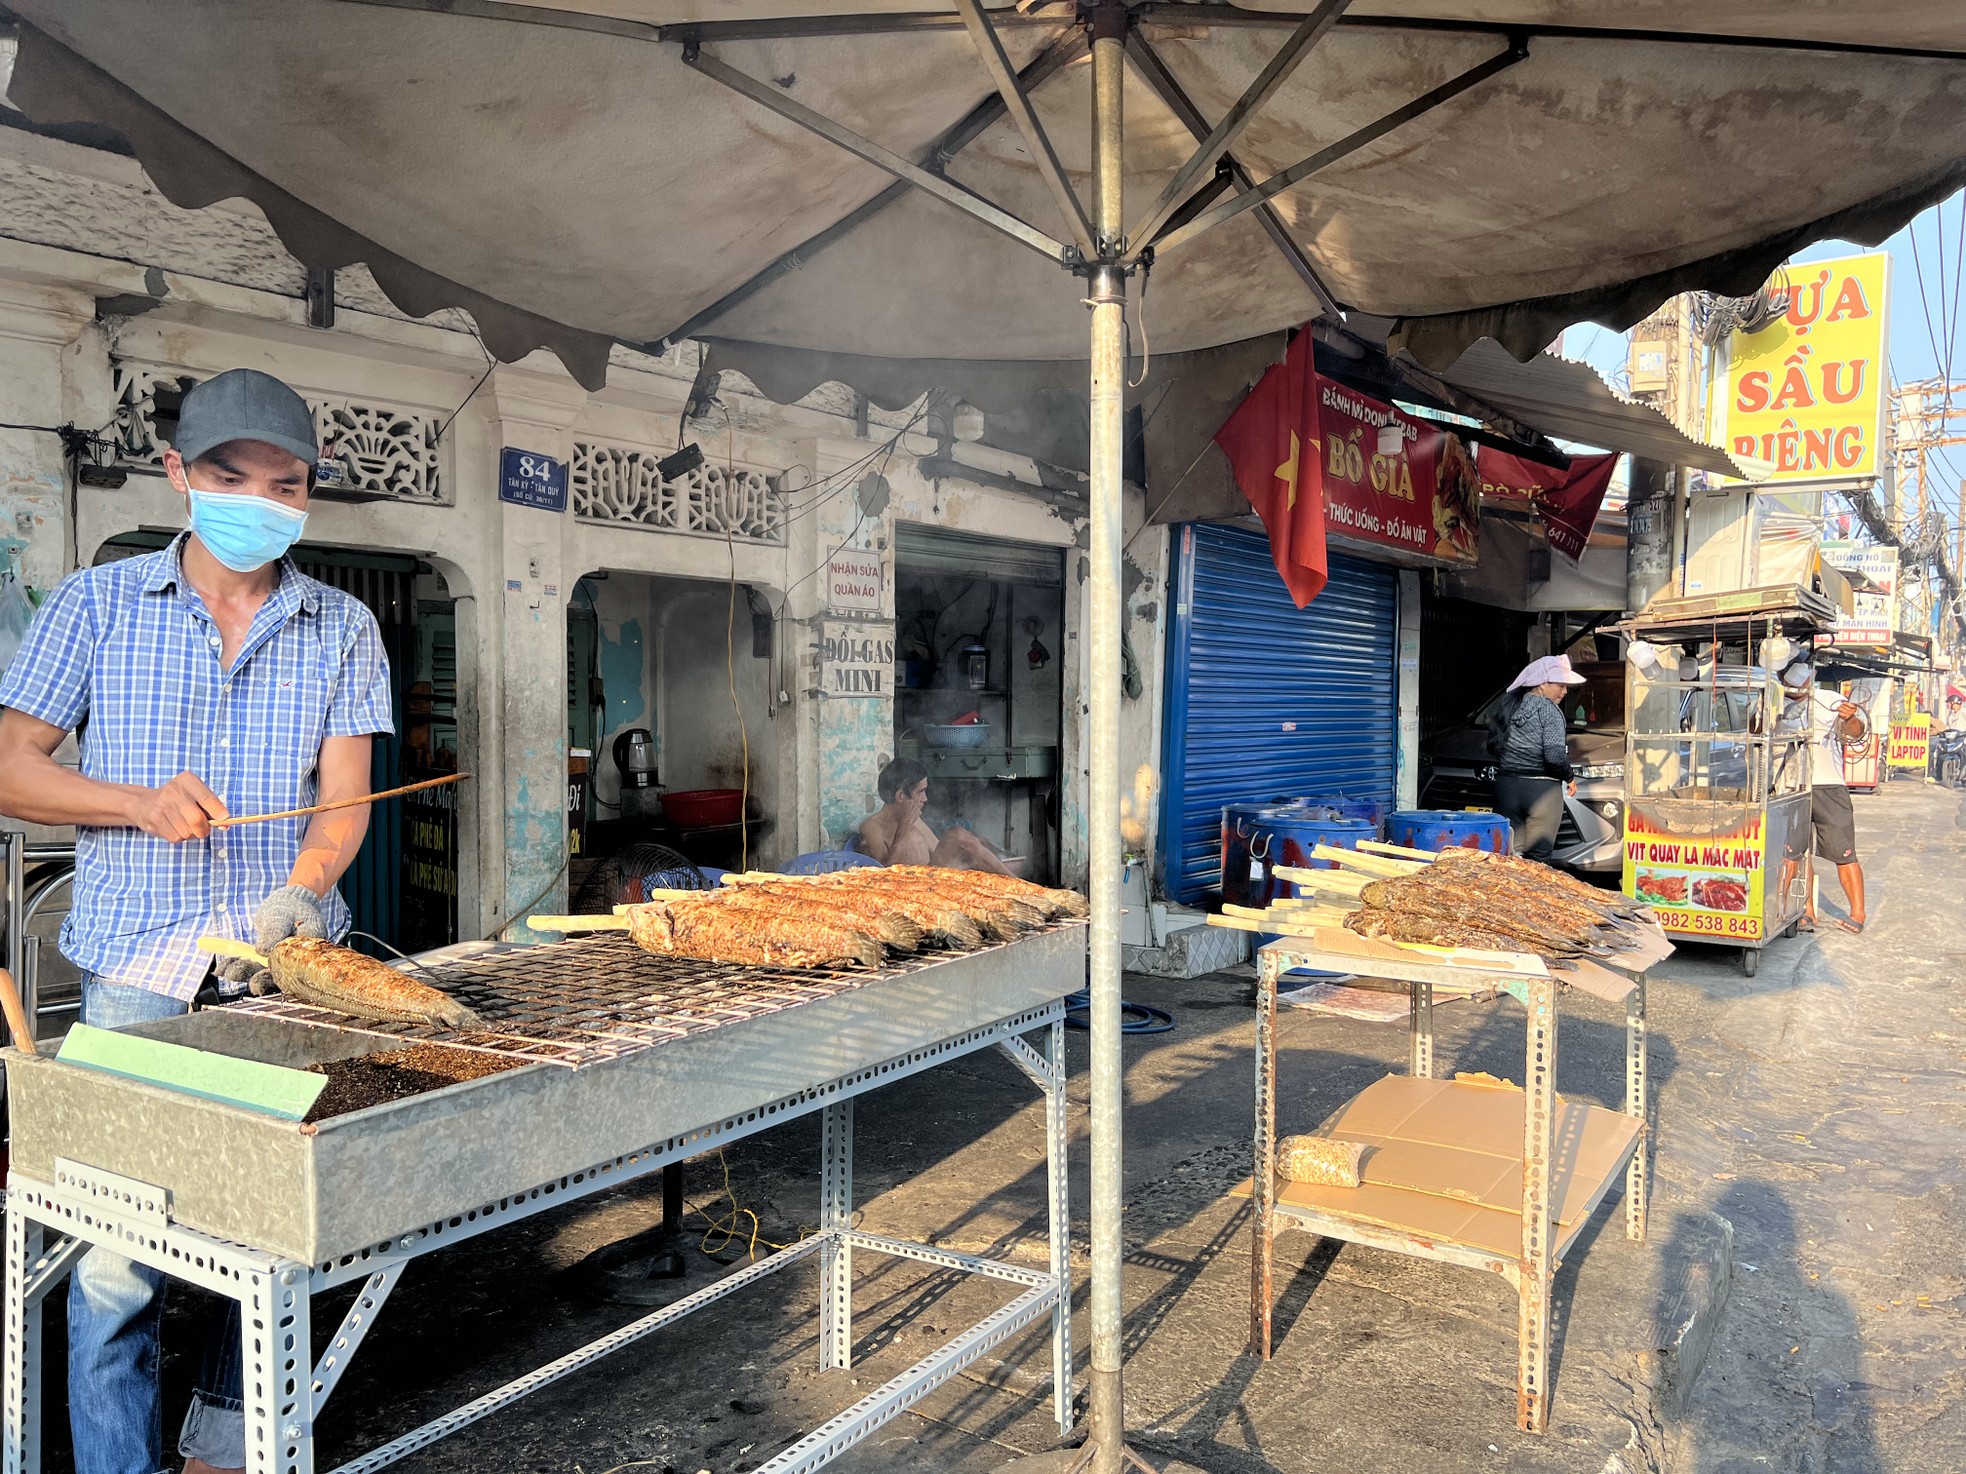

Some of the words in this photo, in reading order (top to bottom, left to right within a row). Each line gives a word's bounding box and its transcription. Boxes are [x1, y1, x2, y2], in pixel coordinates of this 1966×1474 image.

[1770, 269, 1871, 336] ỰA
[1737, 345, 1866, 413] SẦU
[1323, 386, 1351, 415] BÁNH
[519, 456, 551, 481] 84
[1327, 425, 1363, 485] BỐ
[1370, 448, 1415, 502] GIÀ
[1329, 502, 1353, 525] THỨC
[1355, 507, 1379, 533] UỐNG
[1401, 520, 1412, 541] ĂN
[1413, 525, 1427, 548] VẶT
[831, 562, 858, 577] NHẬN
[859, 563, 879, 577] SỬA
[834, 581, 861, 597] QUẦN
[862, 584, 875, 597] ÁO
[834, 669, 881, 692] MINI
[1905, 723, 1927, 741] TÍNH
[1891, 745, 1926, 760] LAPTOP
[1628, 842, 1645, 865] VỊT
[1649, 844, 1680, 863] QUAY
[1695, 915, 1723, 931] 538
[1729, 918, 1758, 935] 843
